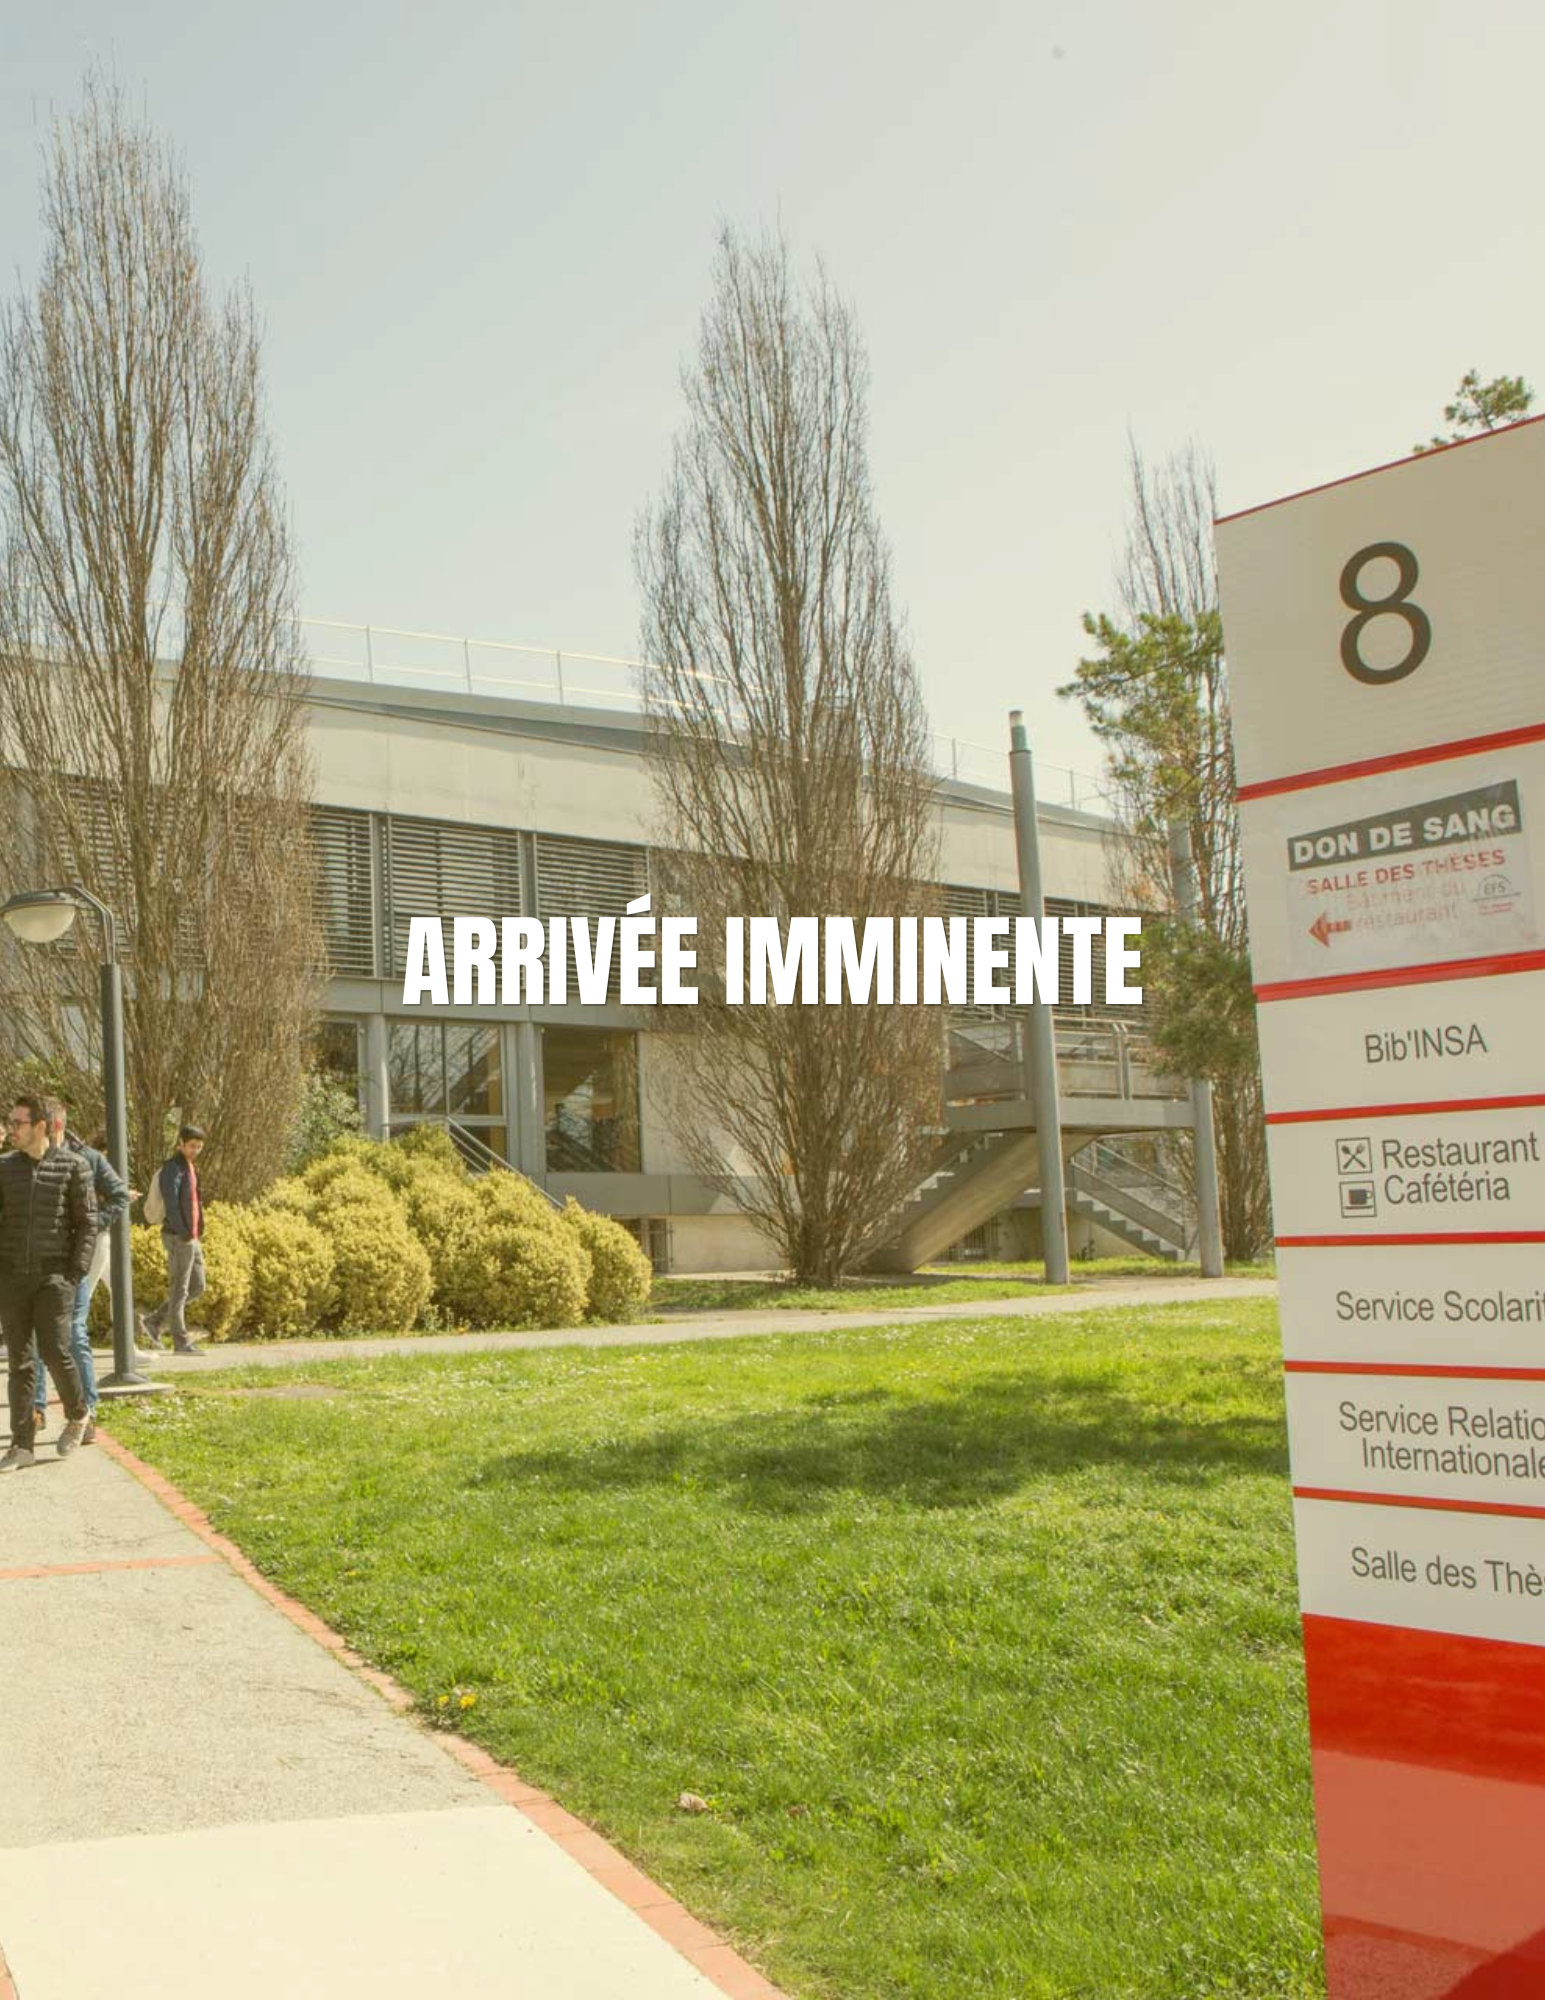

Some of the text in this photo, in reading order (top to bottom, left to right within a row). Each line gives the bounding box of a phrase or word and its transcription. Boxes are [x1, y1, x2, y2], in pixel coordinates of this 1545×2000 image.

[1339, 541, 1432, 685] 8
[1294, 803, 1516, 864] DON DE SANG
[1307, 870, 1369, 895] SALLE
[1375, 863, 1415, 884] DES
[1365, 1023, 1487, 1063] Bib'INSA
[1381, 1131, 1540, 1170] Restaurant
[1383, 1171, 1511, 1204] Cafétéria
[1336, 1290, 1434, 1321] Service
[1339, 1401, 1438, 1435] Service
[1351, 1547, 1545, 1597] Salle des Thè
